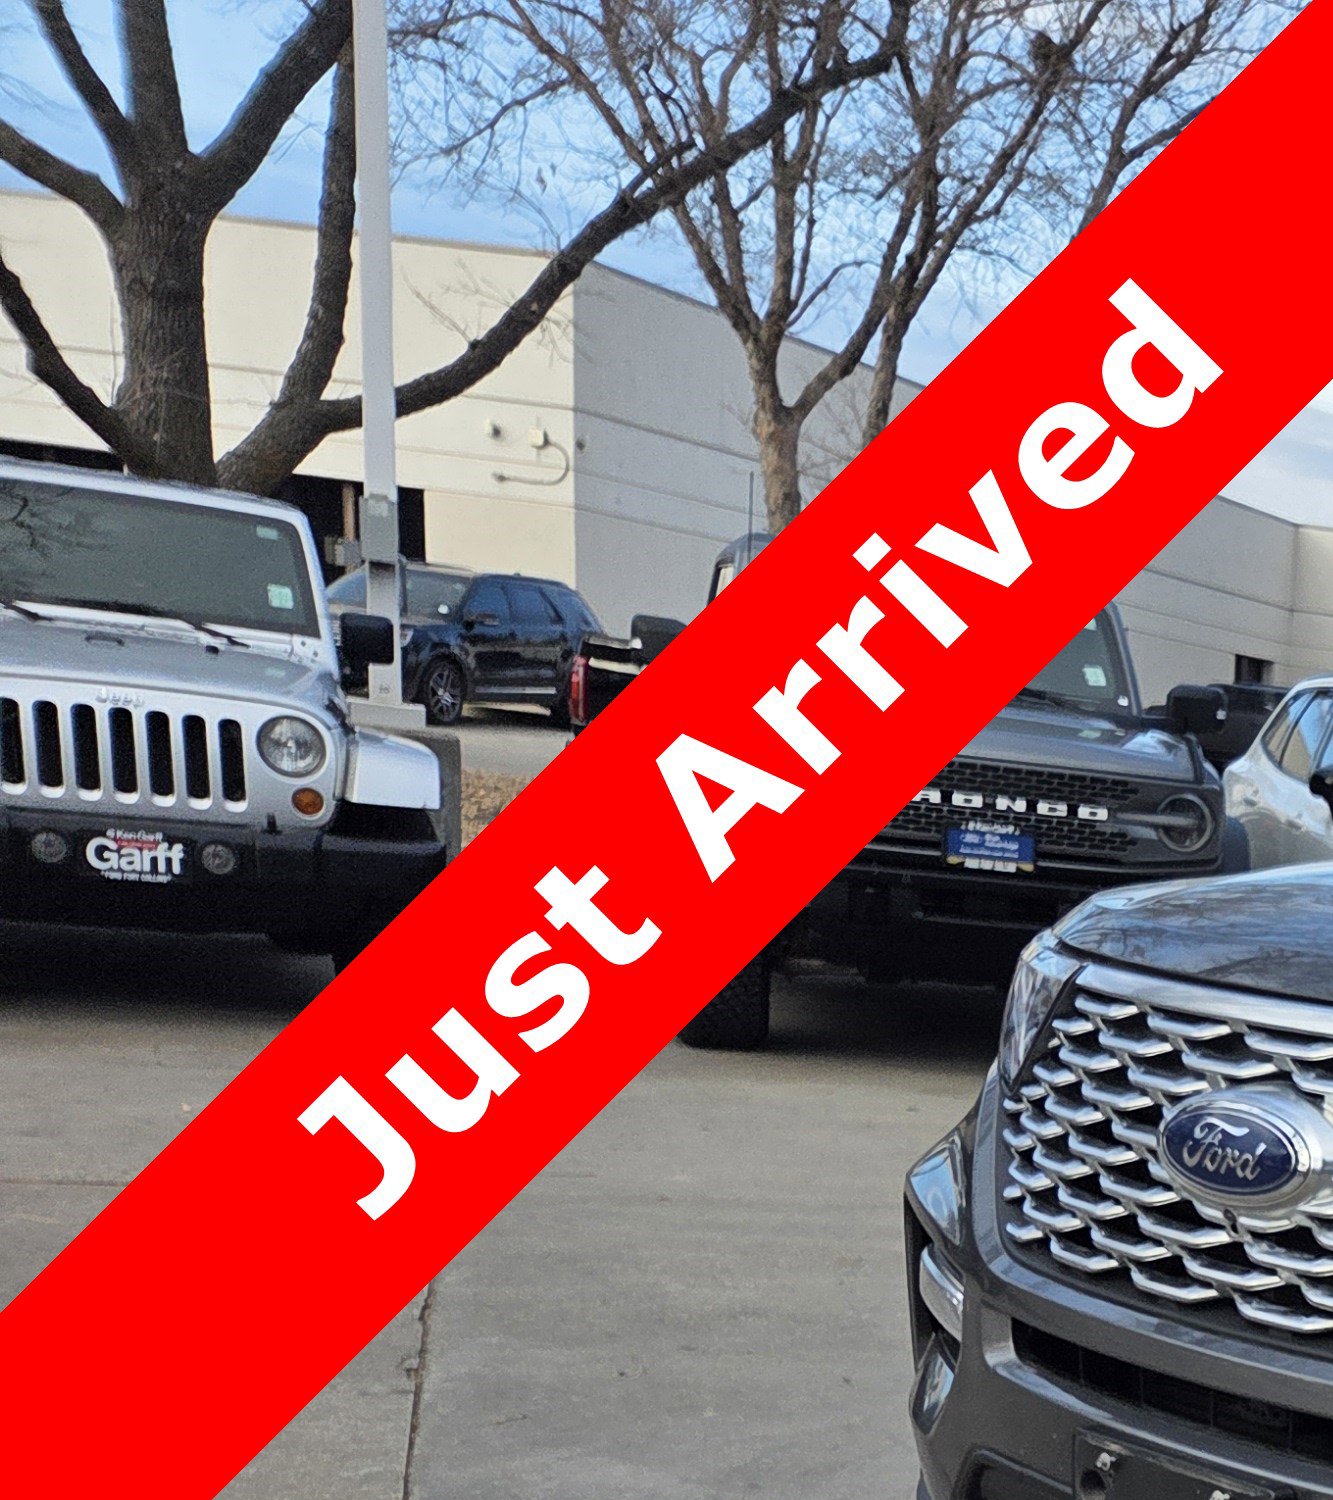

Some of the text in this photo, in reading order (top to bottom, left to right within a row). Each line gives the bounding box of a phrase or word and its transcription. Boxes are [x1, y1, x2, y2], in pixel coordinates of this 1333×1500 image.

[912, 788, 1109, 821] RONCO
[86, 836, 184, 875] Garff
[1183, 1116, 1266, 1181] Ford
